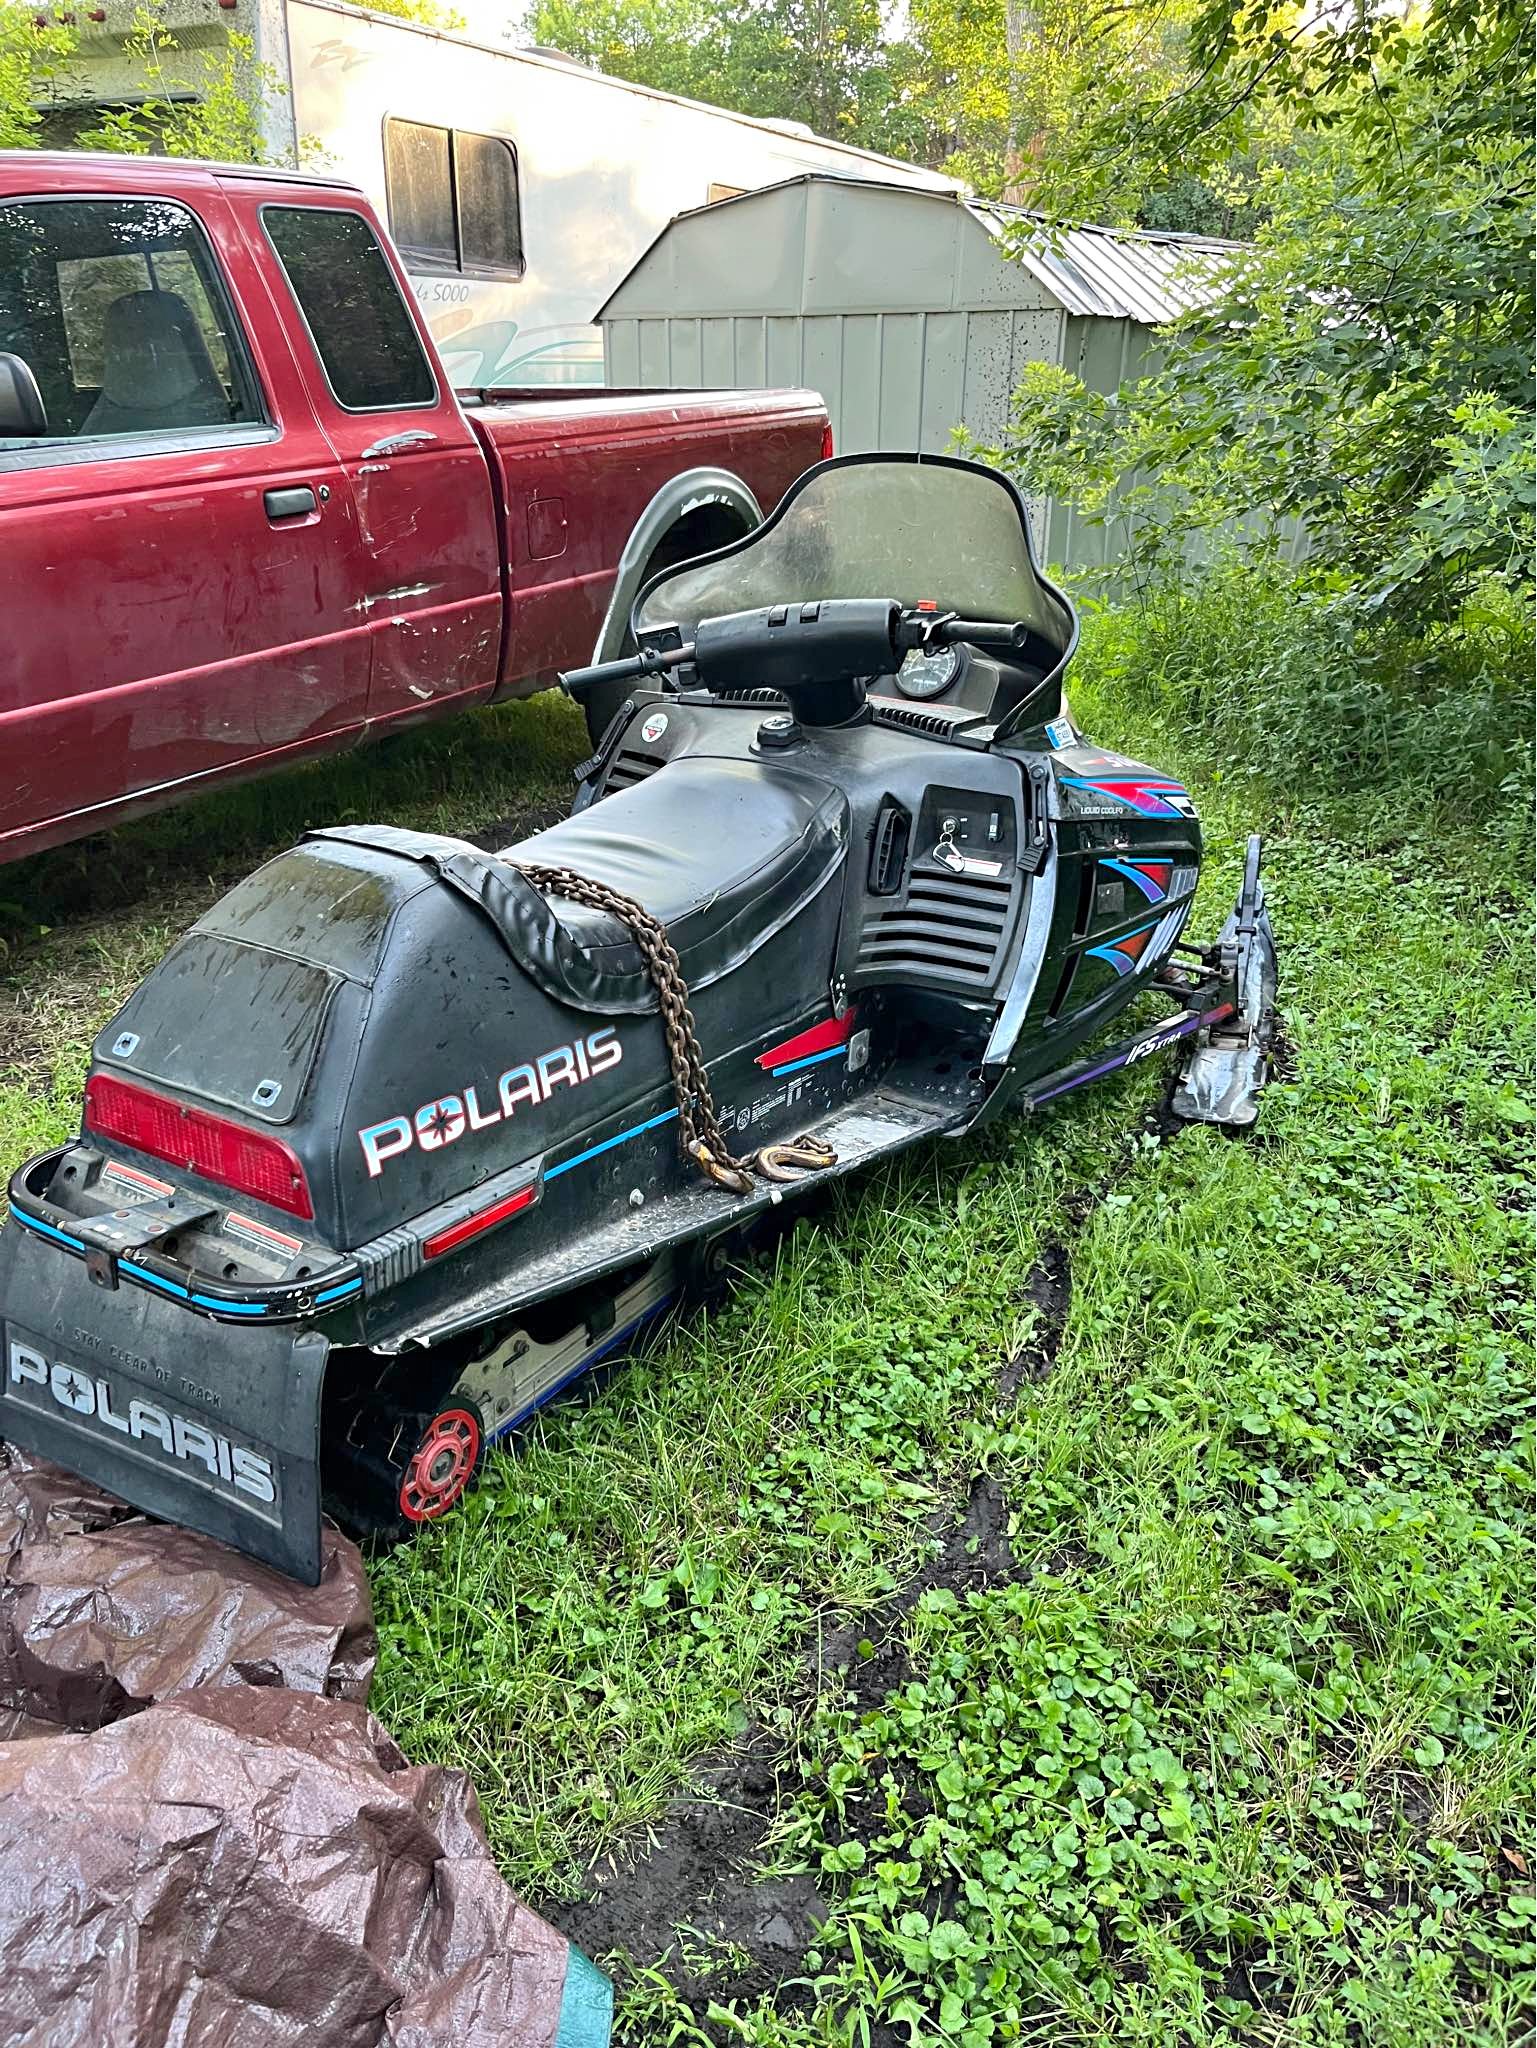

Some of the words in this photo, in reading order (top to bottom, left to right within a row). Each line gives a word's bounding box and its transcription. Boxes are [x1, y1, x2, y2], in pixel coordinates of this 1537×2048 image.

[432, 283, 469, 302] 5000
[1080, 806, 1100, 815] LIQUID
[1124, 1035, 1160, 1066] IFS
[358, 1025, 623, 1179] POLARIS
[74, 1327, 102, 1350] STAY
[155, 1366, 172, 1383] OF
[180, 1376, 222, 1408] TRACK
[10, 1340, 275, 1502] POLARIS
